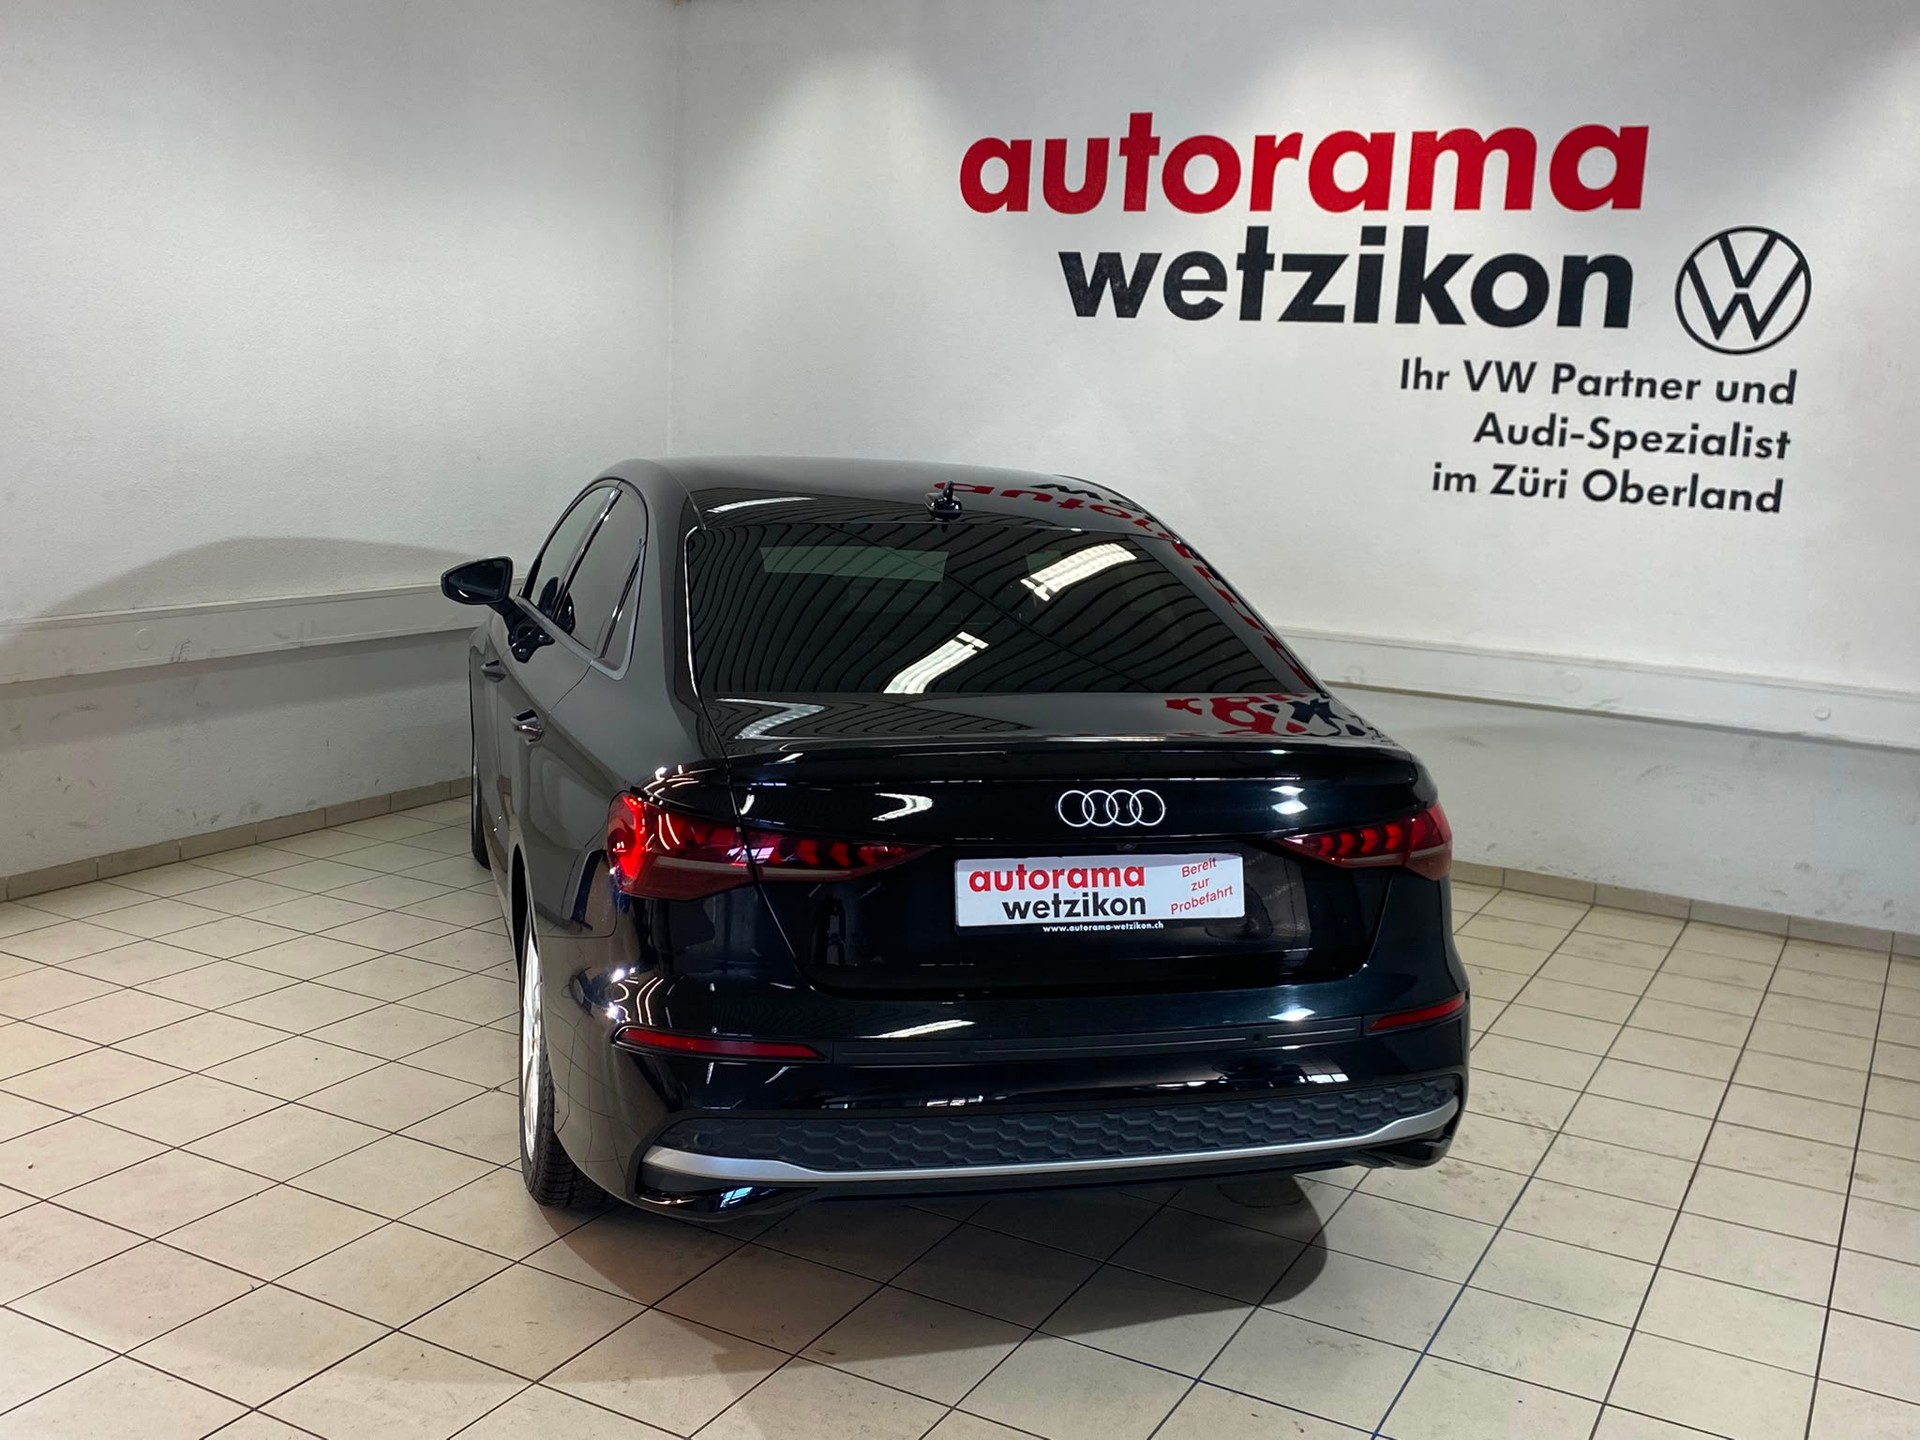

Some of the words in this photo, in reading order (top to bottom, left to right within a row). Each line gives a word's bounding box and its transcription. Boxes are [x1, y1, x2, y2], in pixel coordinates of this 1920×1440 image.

[959, 111, 1650, 214] autorama
[1058, 225, 1634, 329] wetzikon
[1400, 356, 1450, 391] Ihr
[1463, 359, 1538, 394] VW
[1551, 362, 1702, 400] Partner
[1715, 368, 1798, 405] und
[1472, 411, 1792, 461] Audi-Spezialist
[1432, 461, 1477, 494] im
[1489, 463, 1569, 499] Züri
[1582, 468, 1784, 514] Oberland
[968, 863, 1145, 893] autorama
[1181, 857, 1217, 878] Bereit
[1191, 877, 1210, 892] zur
[1001, 891, 1147, 920] wetzikon
[1170, 885, 1233, 915] Probefahrt
[1042, 920, 1164, 933] www.autorama-wetzikon.ch
